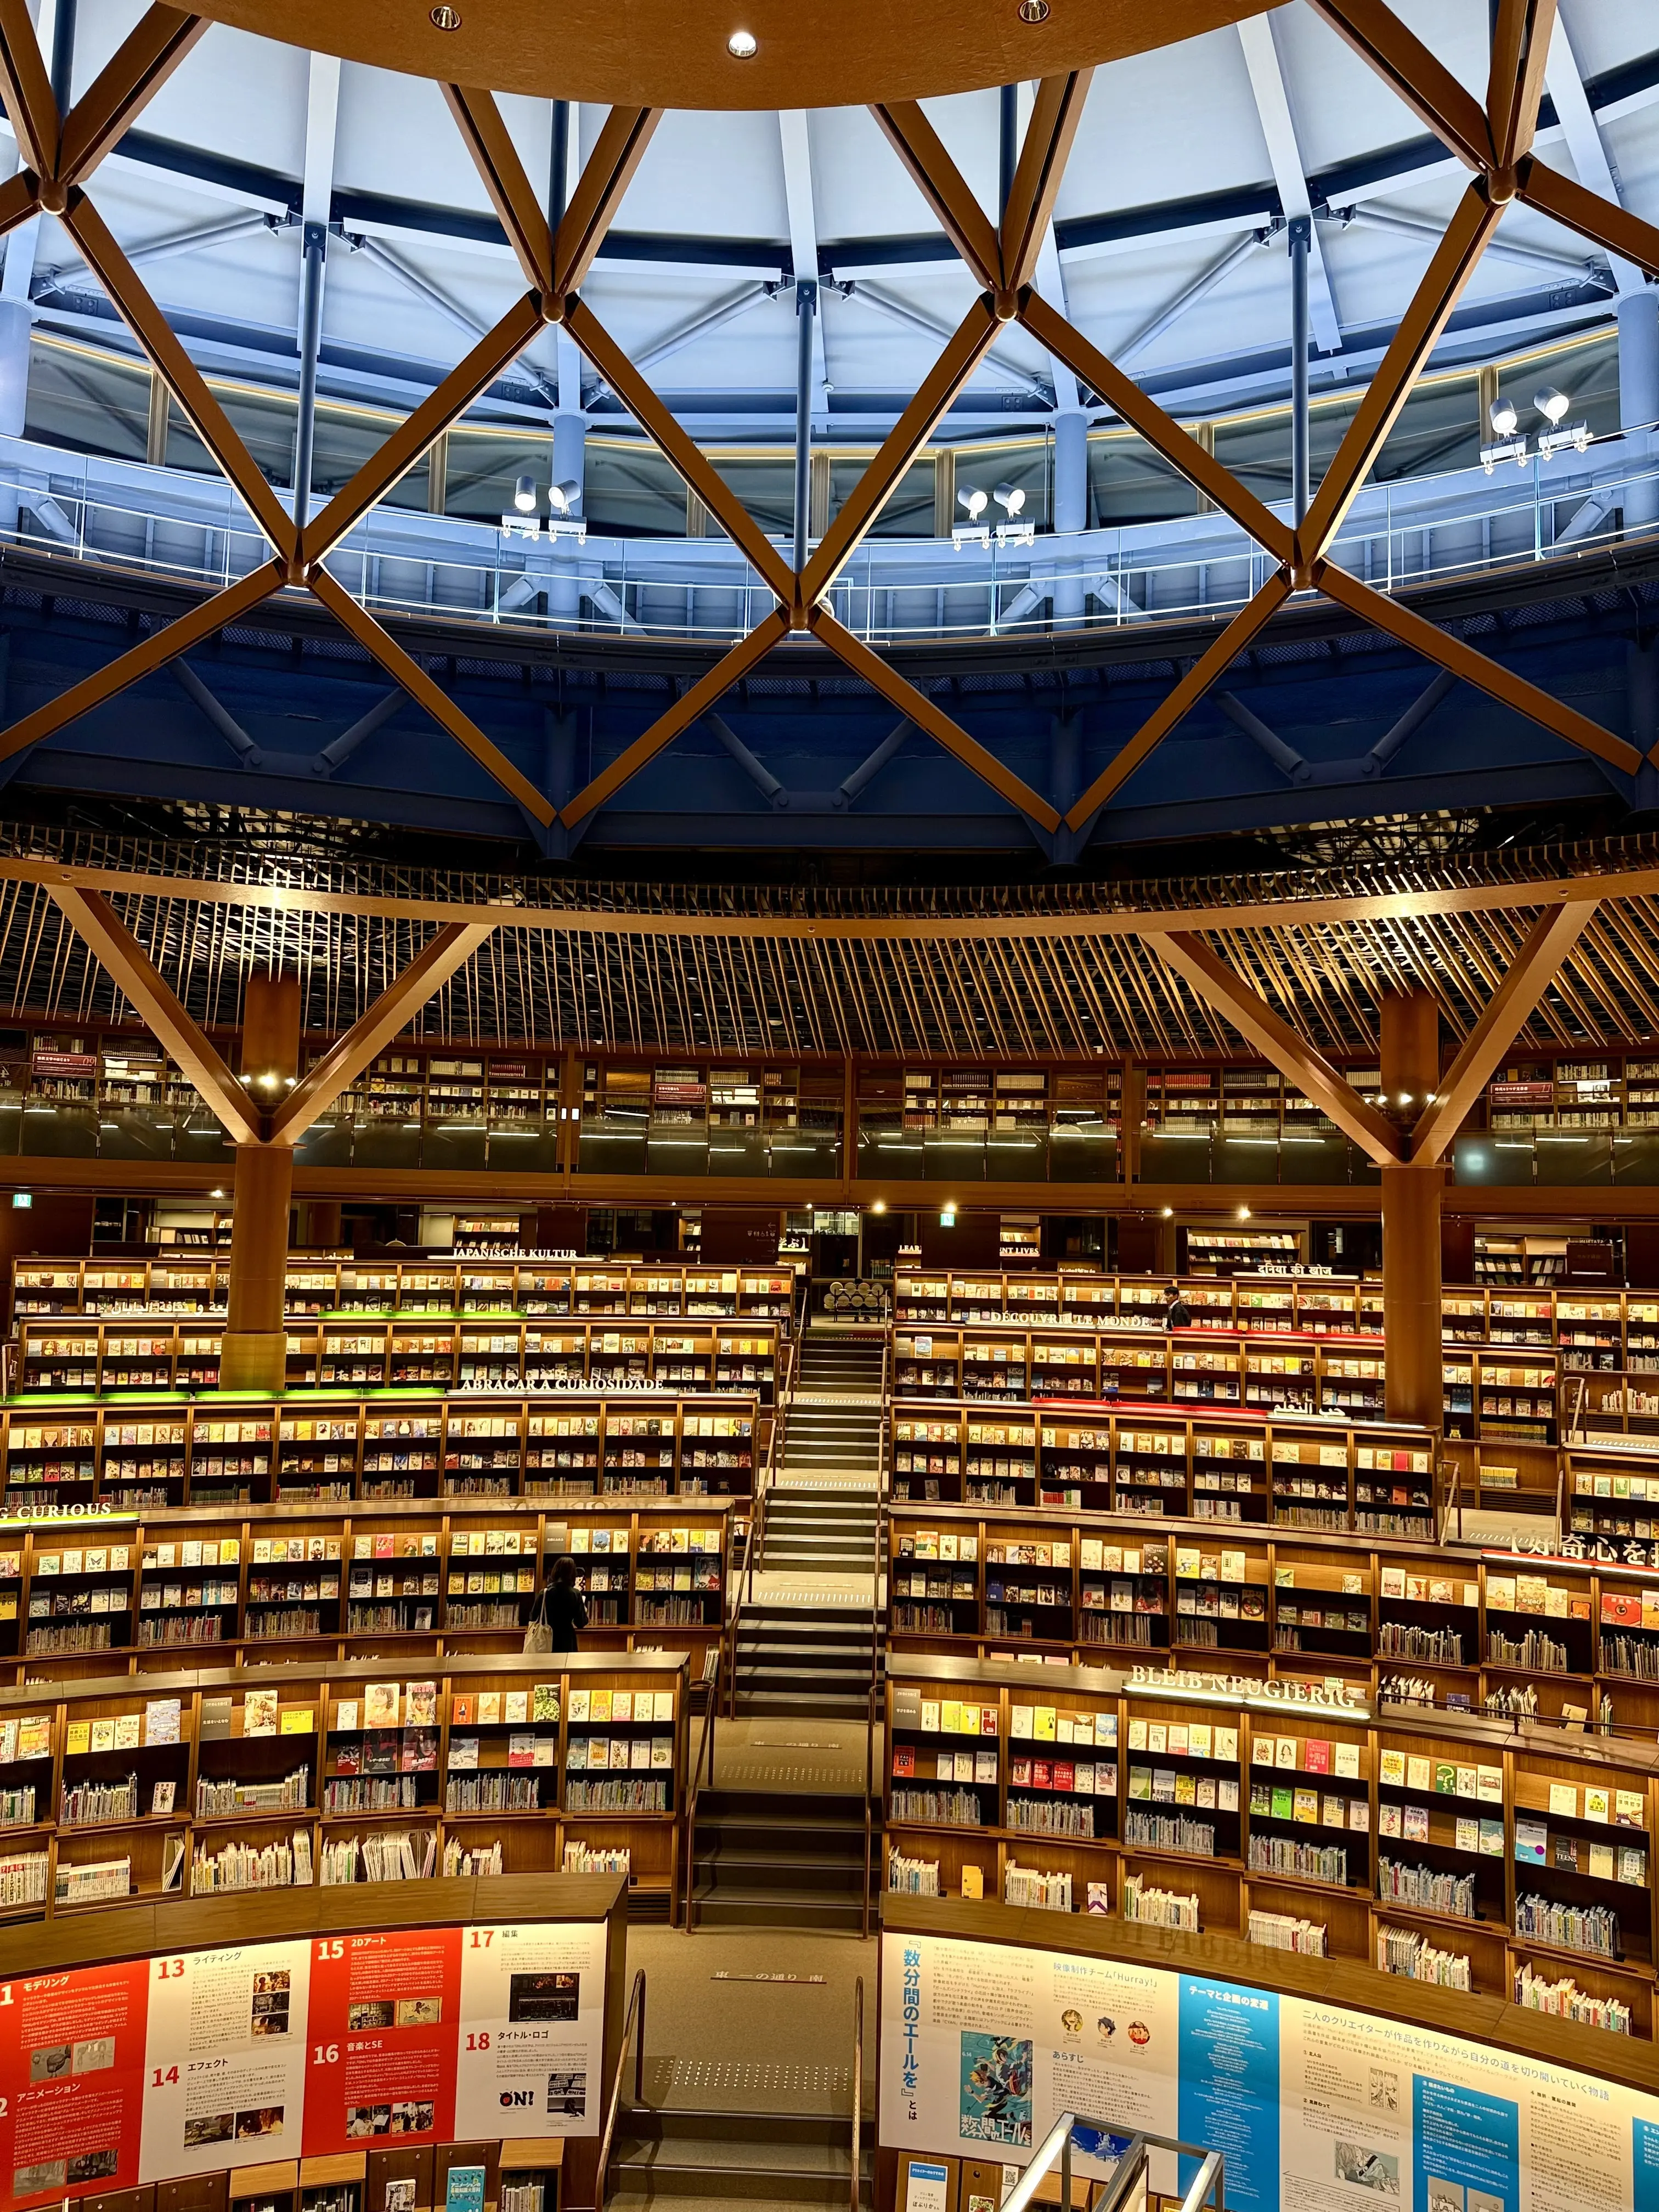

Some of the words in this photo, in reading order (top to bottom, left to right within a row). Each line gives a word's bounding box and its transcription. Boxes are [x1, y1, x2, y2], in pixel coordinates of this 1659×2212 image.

[453, 1248, 526, 1259] JAPANISCHE
[529, 1249, 577, 1259] KULTUR
[1257, 1262, 1287, 1277] दुनिया
[1290, 1263, 1305, 1274] की
[1308, 1264, 1332, 1275] खोज
[194, 1304, 204, 1316] و
[991, 1310, 1072, 1324] DÉCOUVRIR
[1076, 1314, 1093, 1325] LE
[1097, 1316, 1150, 1327] MONDE
[461, 1379, 535, 1392] ABRAÇAR
[540, 1379, 550, 1389] A
[555, 1379, 664, 1390] CURIOSIDADE
[1273, 1401, 1313, 1416] التعلم
[1319, 1408, 1345, 1418] حب
[17, 1502, 111, 1519] CURIOUS
[1131, 1664, 1202, 1689] BLEIB
[1211, 1676, 1356, 1708] NEUGIERIG
[1406, 1813, 1426, 1825] 世界史
[1556, 1853, 1577, 1861] TEENS
[351, 1937, 386, 1947] 2Dアート
[471, 1931, 494, 1949] 17
[192, 1950, 241, 1965] ライティング
[318, 1940, 344, 1960] 15
[157, 1959, 185, 1980] 13
[1054, 1962, 1157, 1988] 映像制作チーム「Hurray!」
[23, 1976, 70, 1992] モデリング
[1189, 1985, 1269, 2011] テーマと企画の変遷
[465, 2032, 490, 2051] 18
[498, 2030, 549, 2040] タイトル・ロゴ
[347, 2040, 383, 2052] 音楽とSE
[313, 2044, 339, 2064] 16
[1053, 2051, 1084, 2063] あらすじ
[1303, 2010, 1610, 2101] 二人のクリエイターが作品を作りながら自分の道を切り開いていく物語
[188, 2058, 228, 2071] エフェクト
[151, 2064, 179, 2088] 14
[17, 2083, 81, 2102] アニメーション
